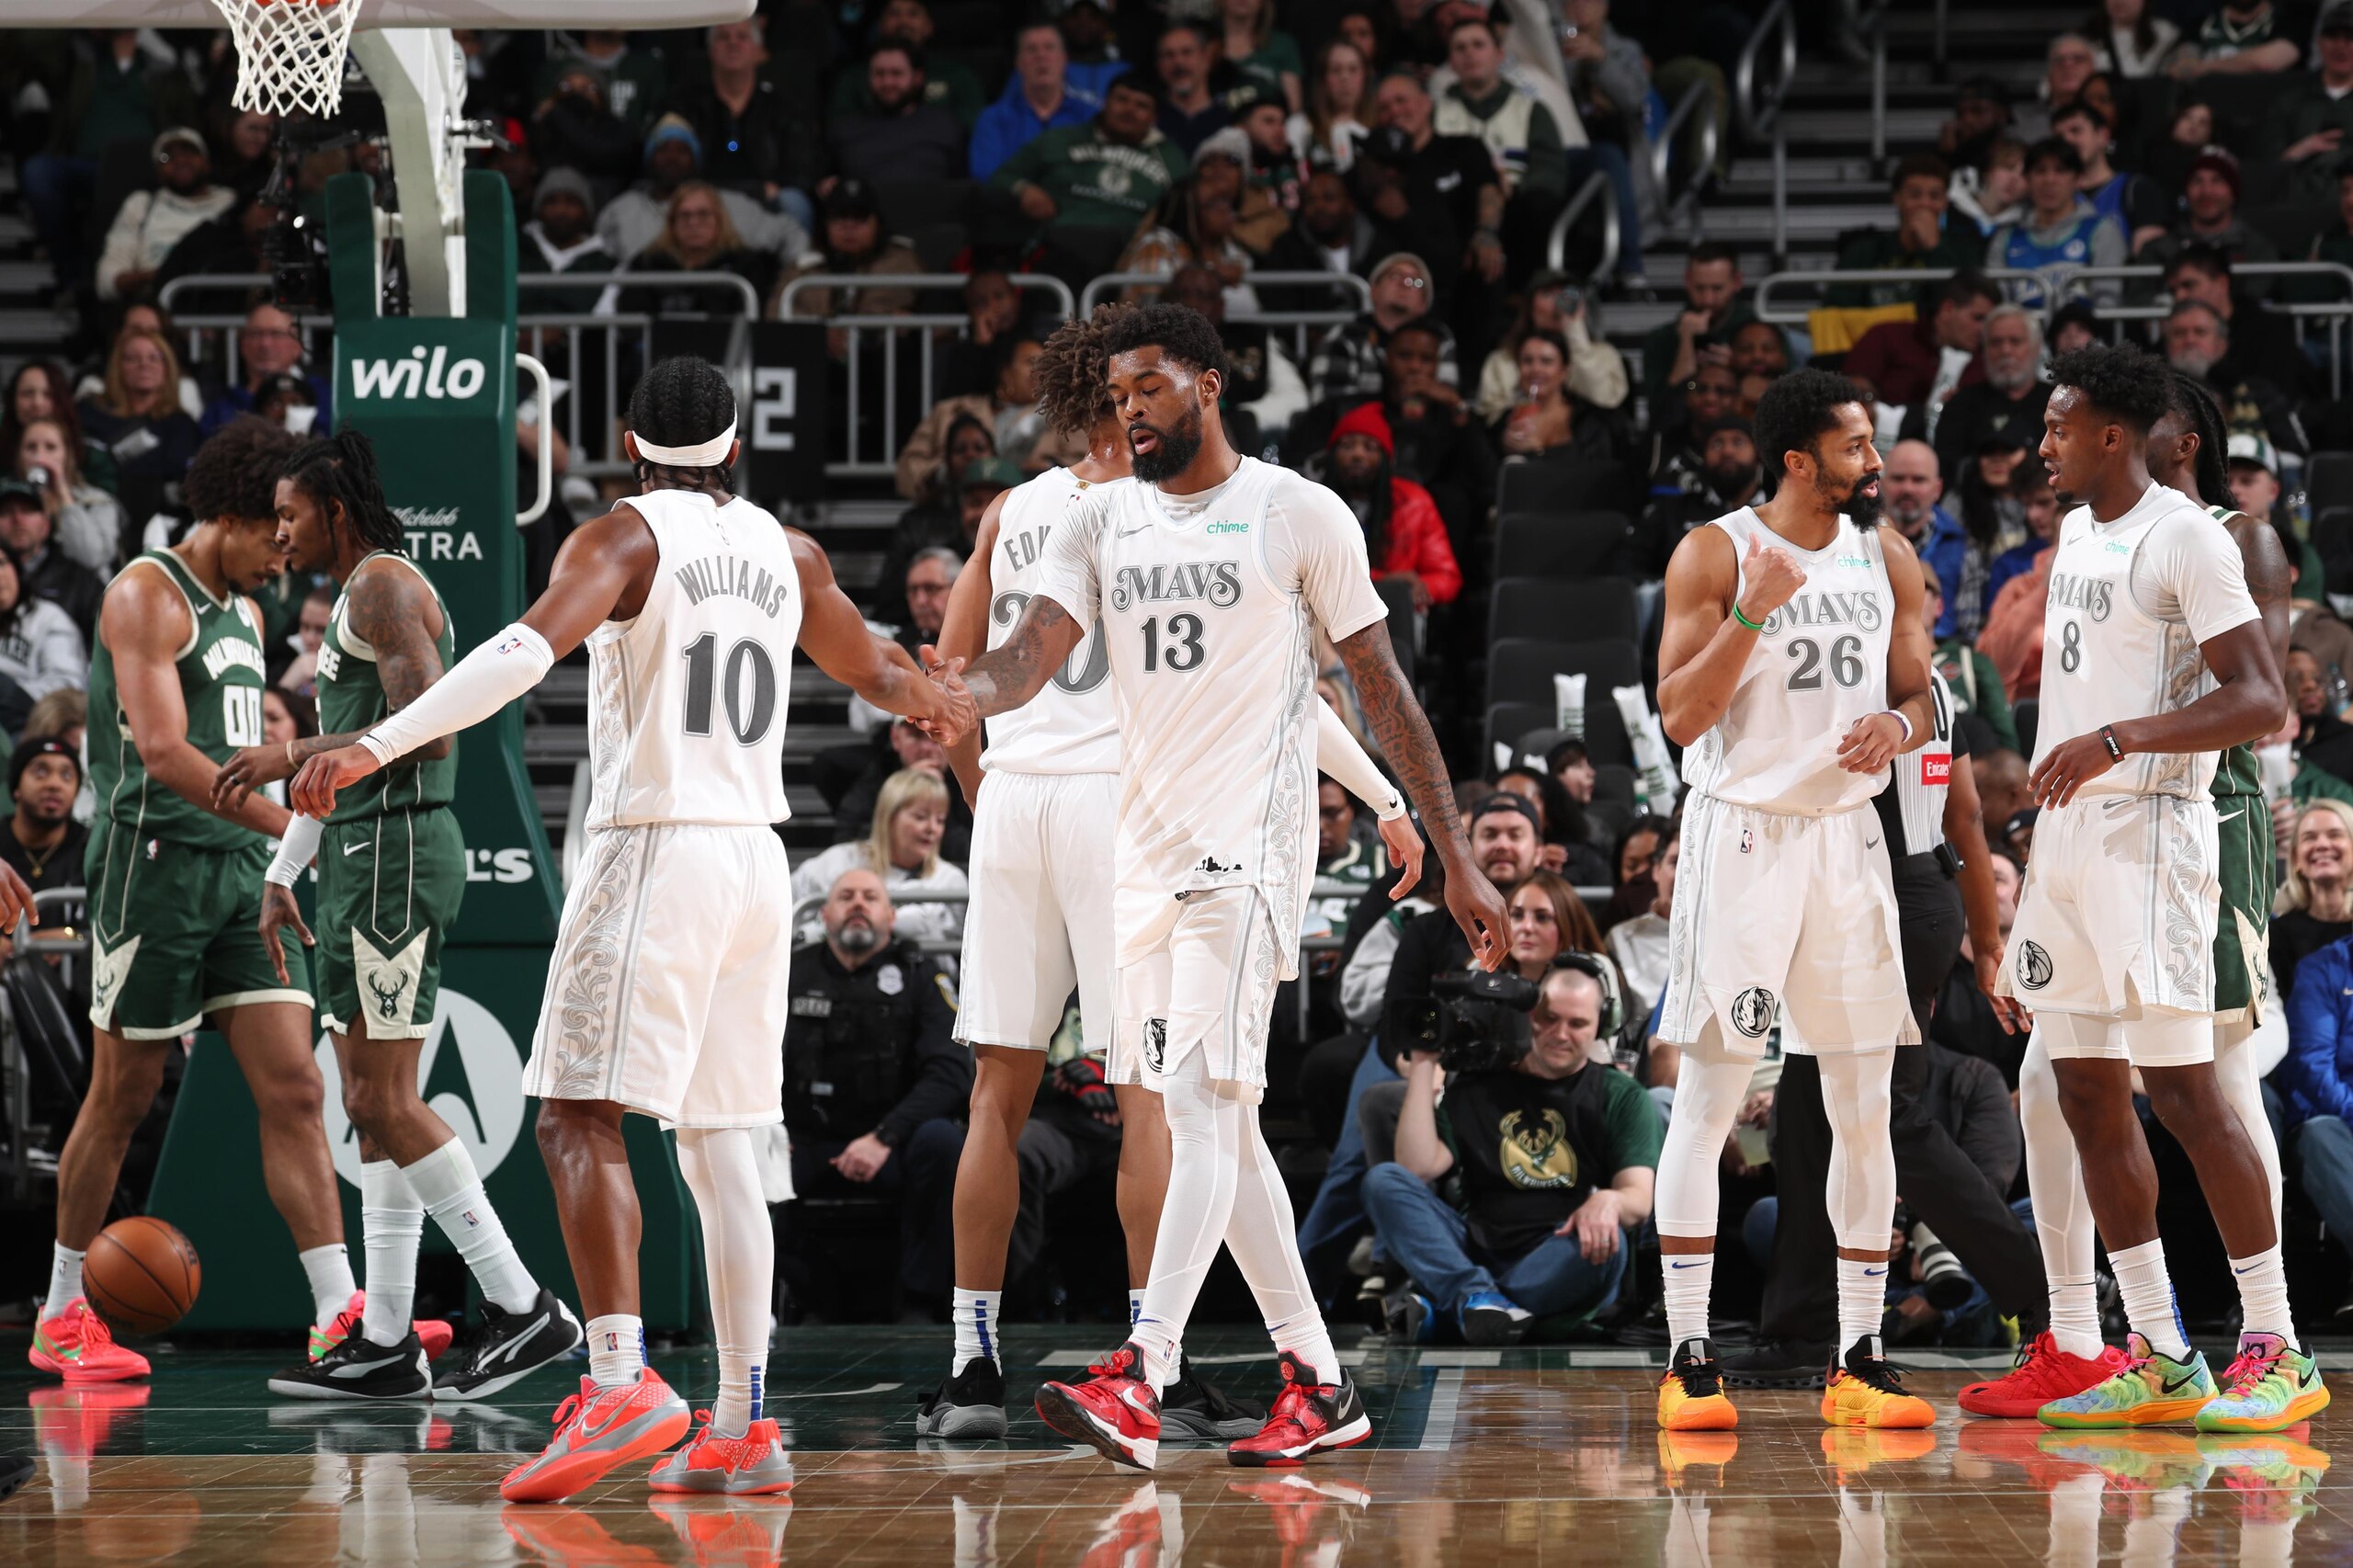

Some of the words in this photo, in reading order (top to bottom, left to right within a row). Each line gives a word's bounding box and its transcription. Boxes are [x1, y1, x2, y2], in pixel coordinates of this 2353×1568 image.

[351, 345, 486, 399] wilo
[404, 531, 483, 561] TRA
[1207, 519, 1249, 534] chime
[2105, 540, 2131, 555] chime
[674, 555, 788, 619] WILLIAMS
[1111, 560, 1245, 613] MAVS
[1838, 555, 1871, 568] chime
[1760, 590, 1884, 636] MAVS
[2048, 572, 2116, 625] MAVS
[1139, 611, 1207, 673] 13
[1785, 633, 1865, 692] 26
[2061, 619, 2082, 675] 8
[222, 685, 263, 747] 00
[681, 631, 778, 748] 10
